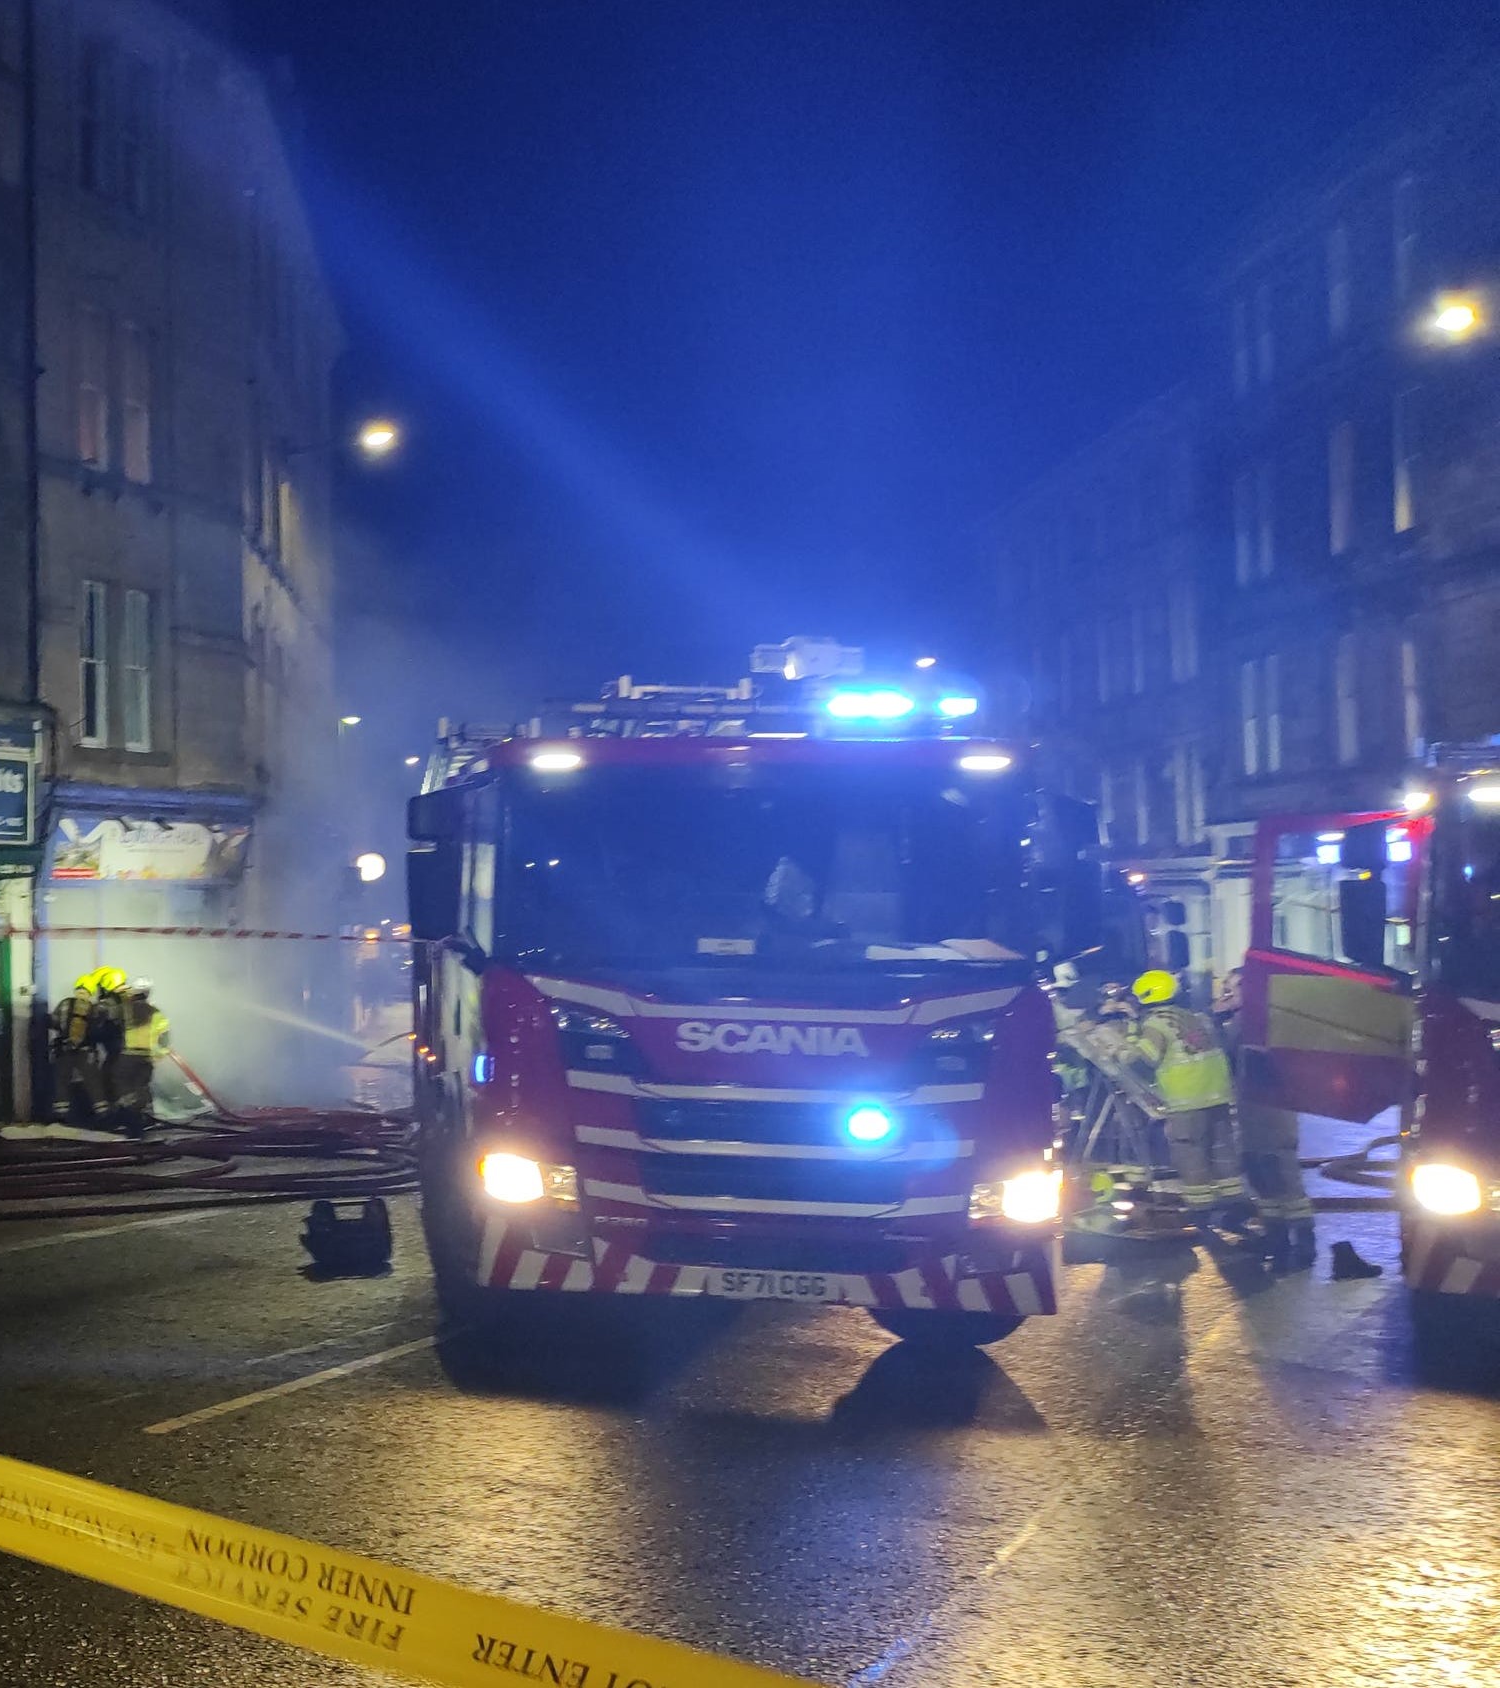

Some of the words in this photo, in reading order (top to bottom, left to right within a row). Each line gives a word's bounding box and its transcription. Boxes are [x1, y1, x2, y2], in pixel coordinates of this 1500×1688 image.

[675, 1022, 869, 1057] SCANIA
[183, 1527, 309, 1584] CORDON
[176, 1563, 314, 1621] SERVICE
[316, 1561, 417, 1616] INNER
[322, 1604, 407, 1652] FIRE
[470, 1633, 591, 1688] ENTER
